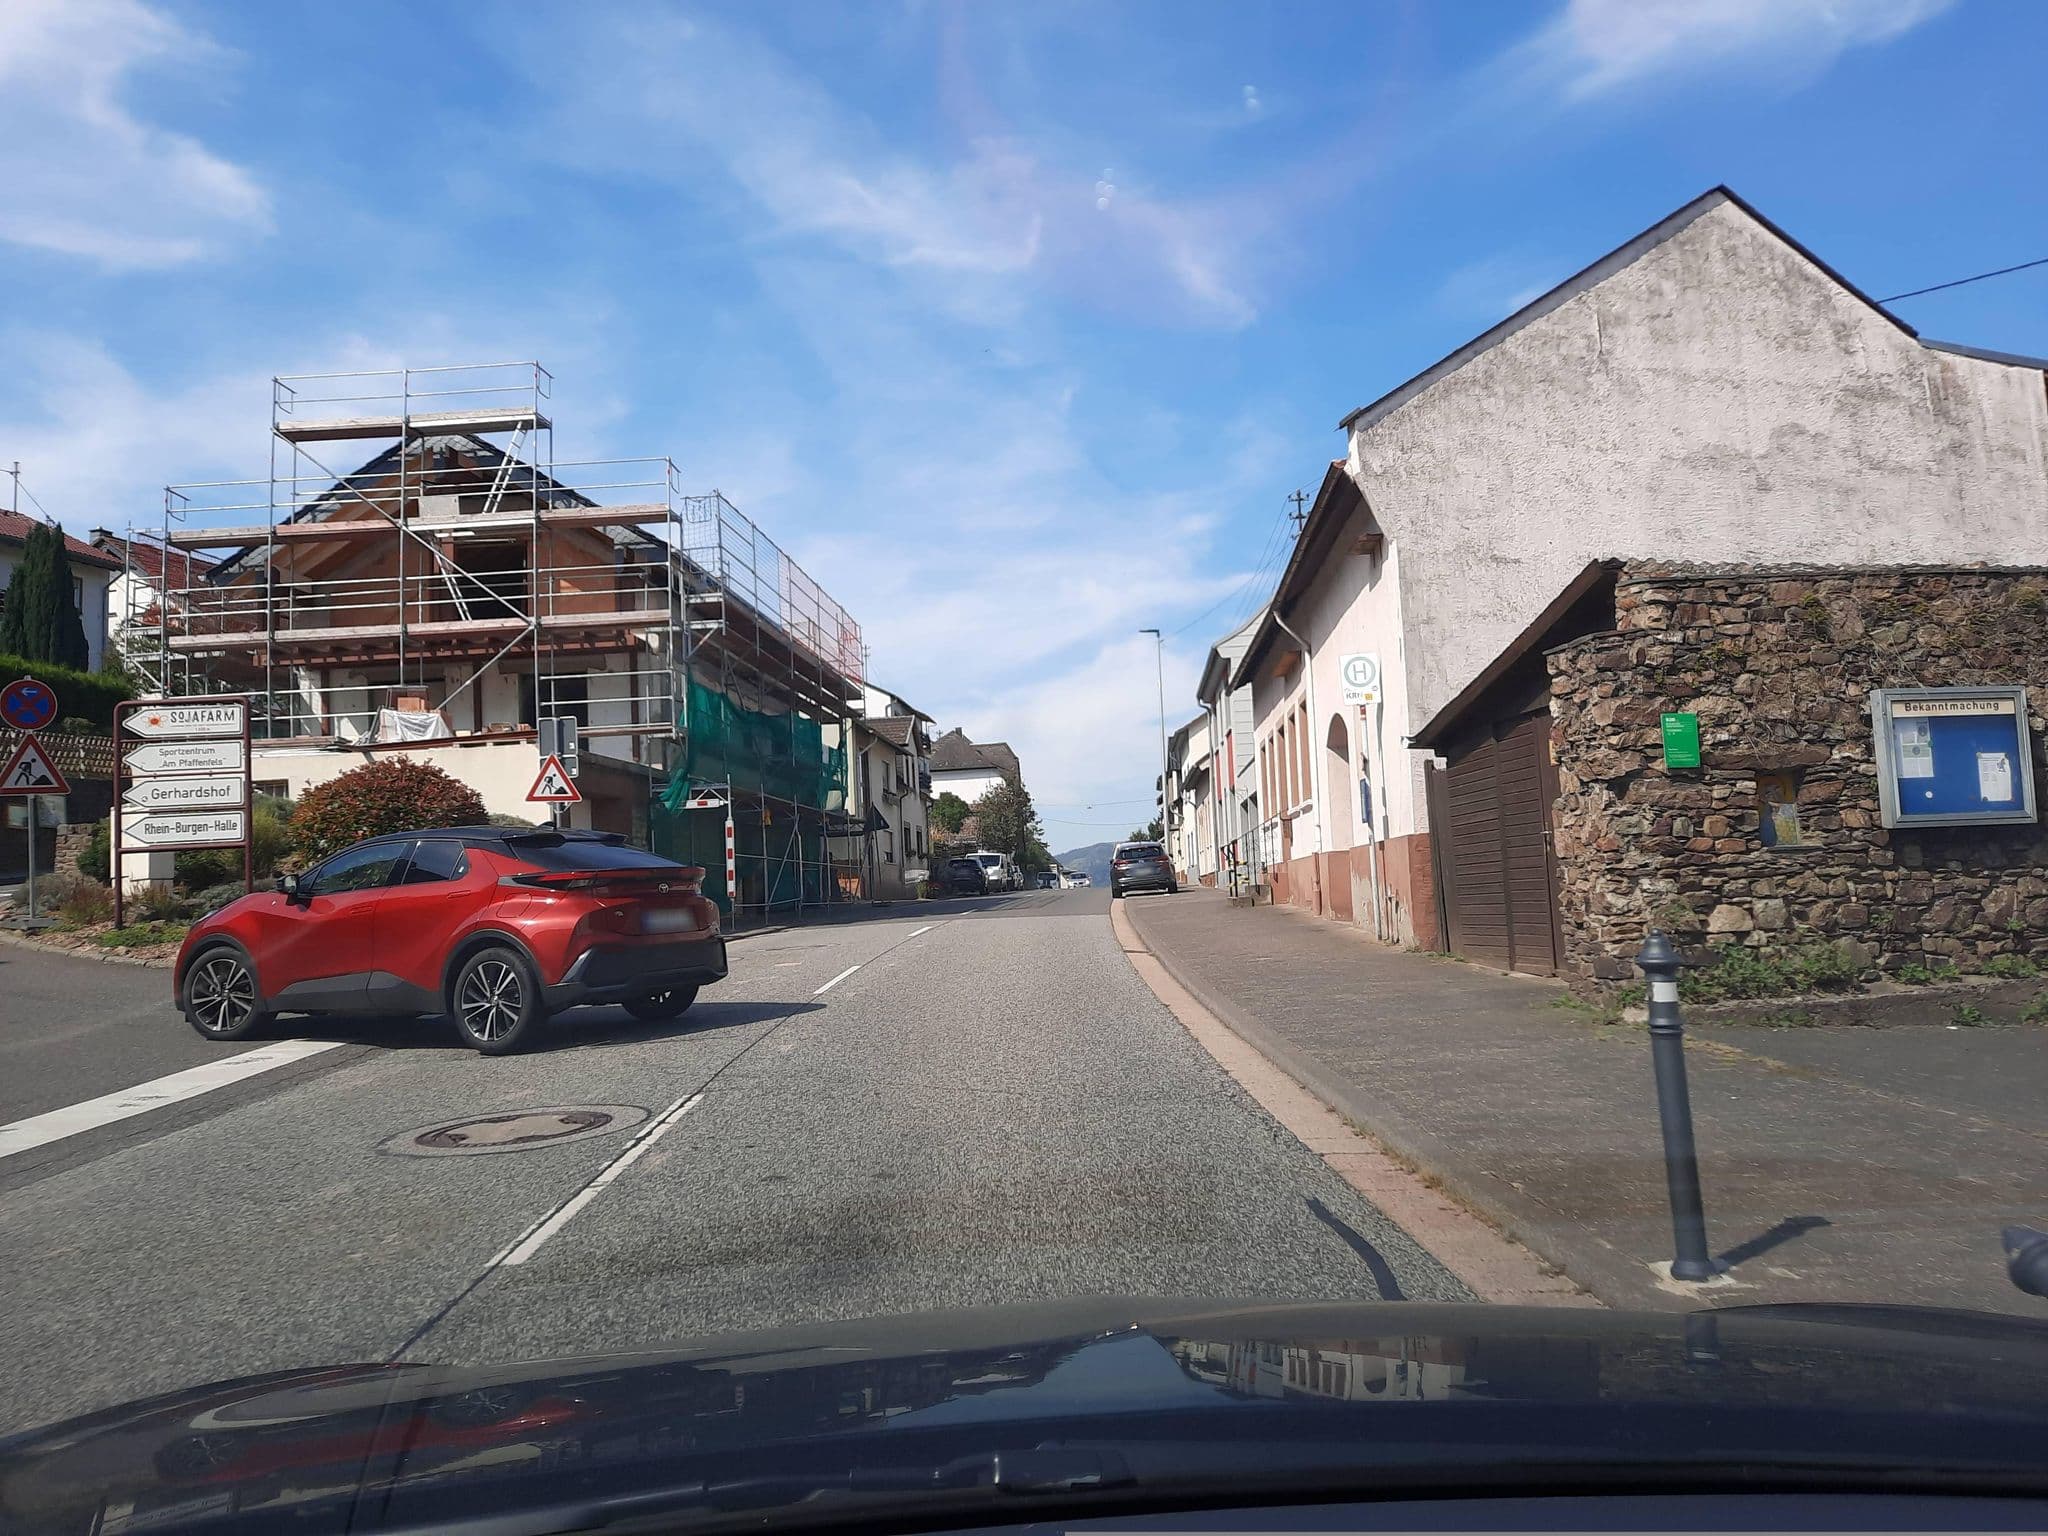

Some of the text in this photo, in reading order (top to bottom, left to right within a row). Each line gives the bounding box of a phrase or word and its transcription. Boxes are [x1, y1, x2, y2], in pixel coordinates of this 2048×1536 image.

[1352, 662, 1367, 681] H
[1904, 701, 2000, 712] Bekanntmachung
[159, 747, 216, 757] Sportzentrum
[151, 785, 231, 800] Gerhardshof
[144, 820, 238, 836] Rhein-Burgen-Halle
